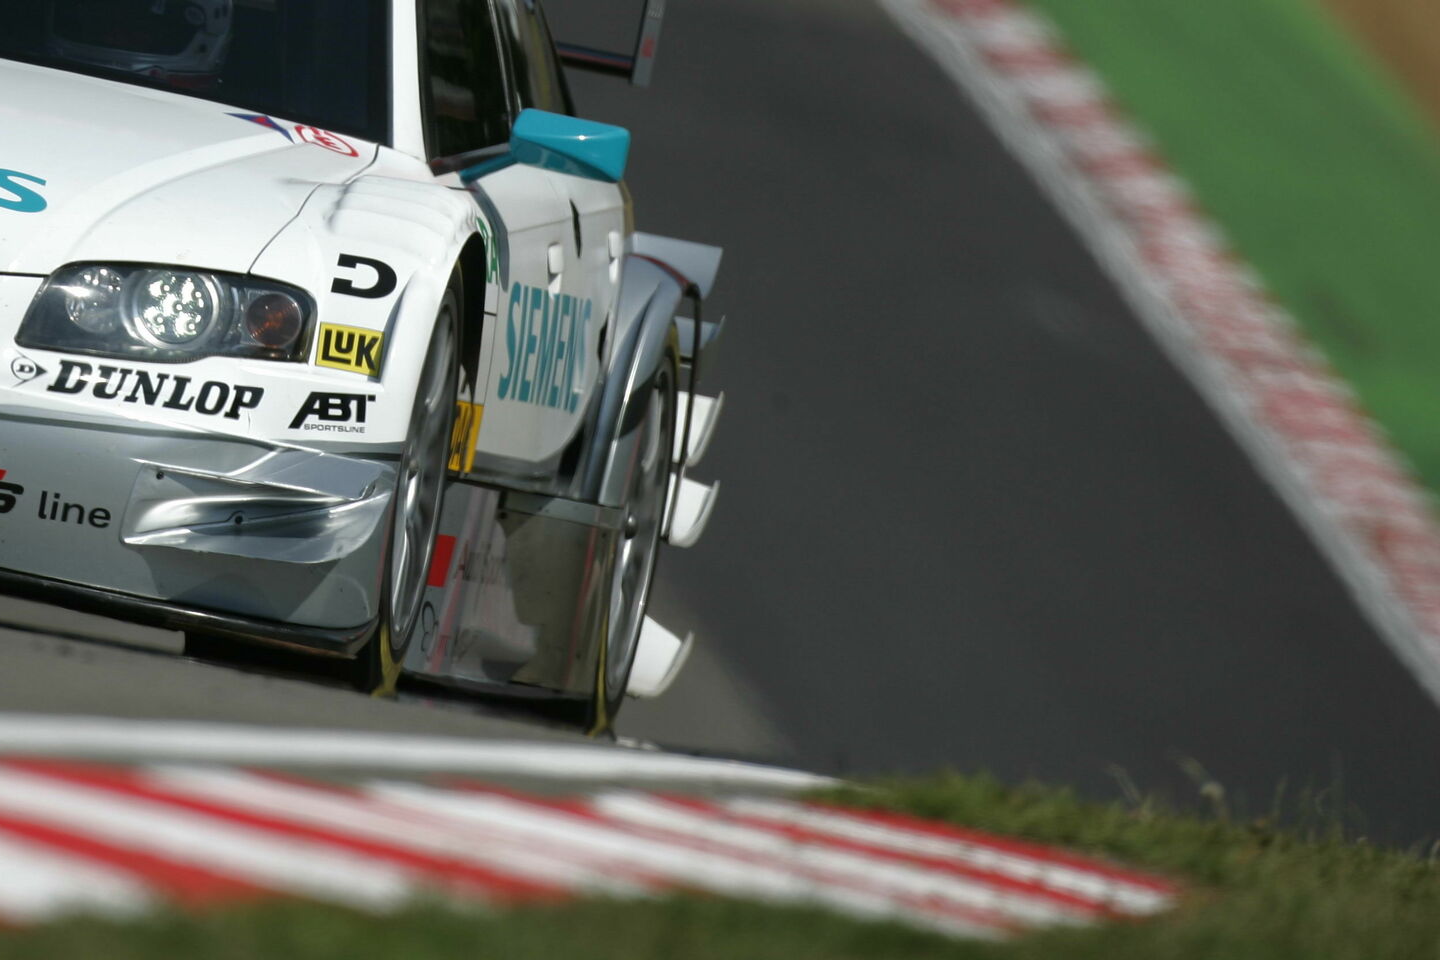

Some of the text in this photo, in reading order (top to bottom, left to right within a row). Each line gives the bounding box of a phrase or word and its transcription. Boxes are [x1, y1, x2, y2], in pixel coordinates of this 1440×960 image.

[497, 281, 592, 415] SIEMENS
[47, 359, 265, 420] DUNLOP
[288, 391, 376, 429] ABT
[303, 423, 366, 434] SPORTSLINE
[37, 490, 112, 529] line
